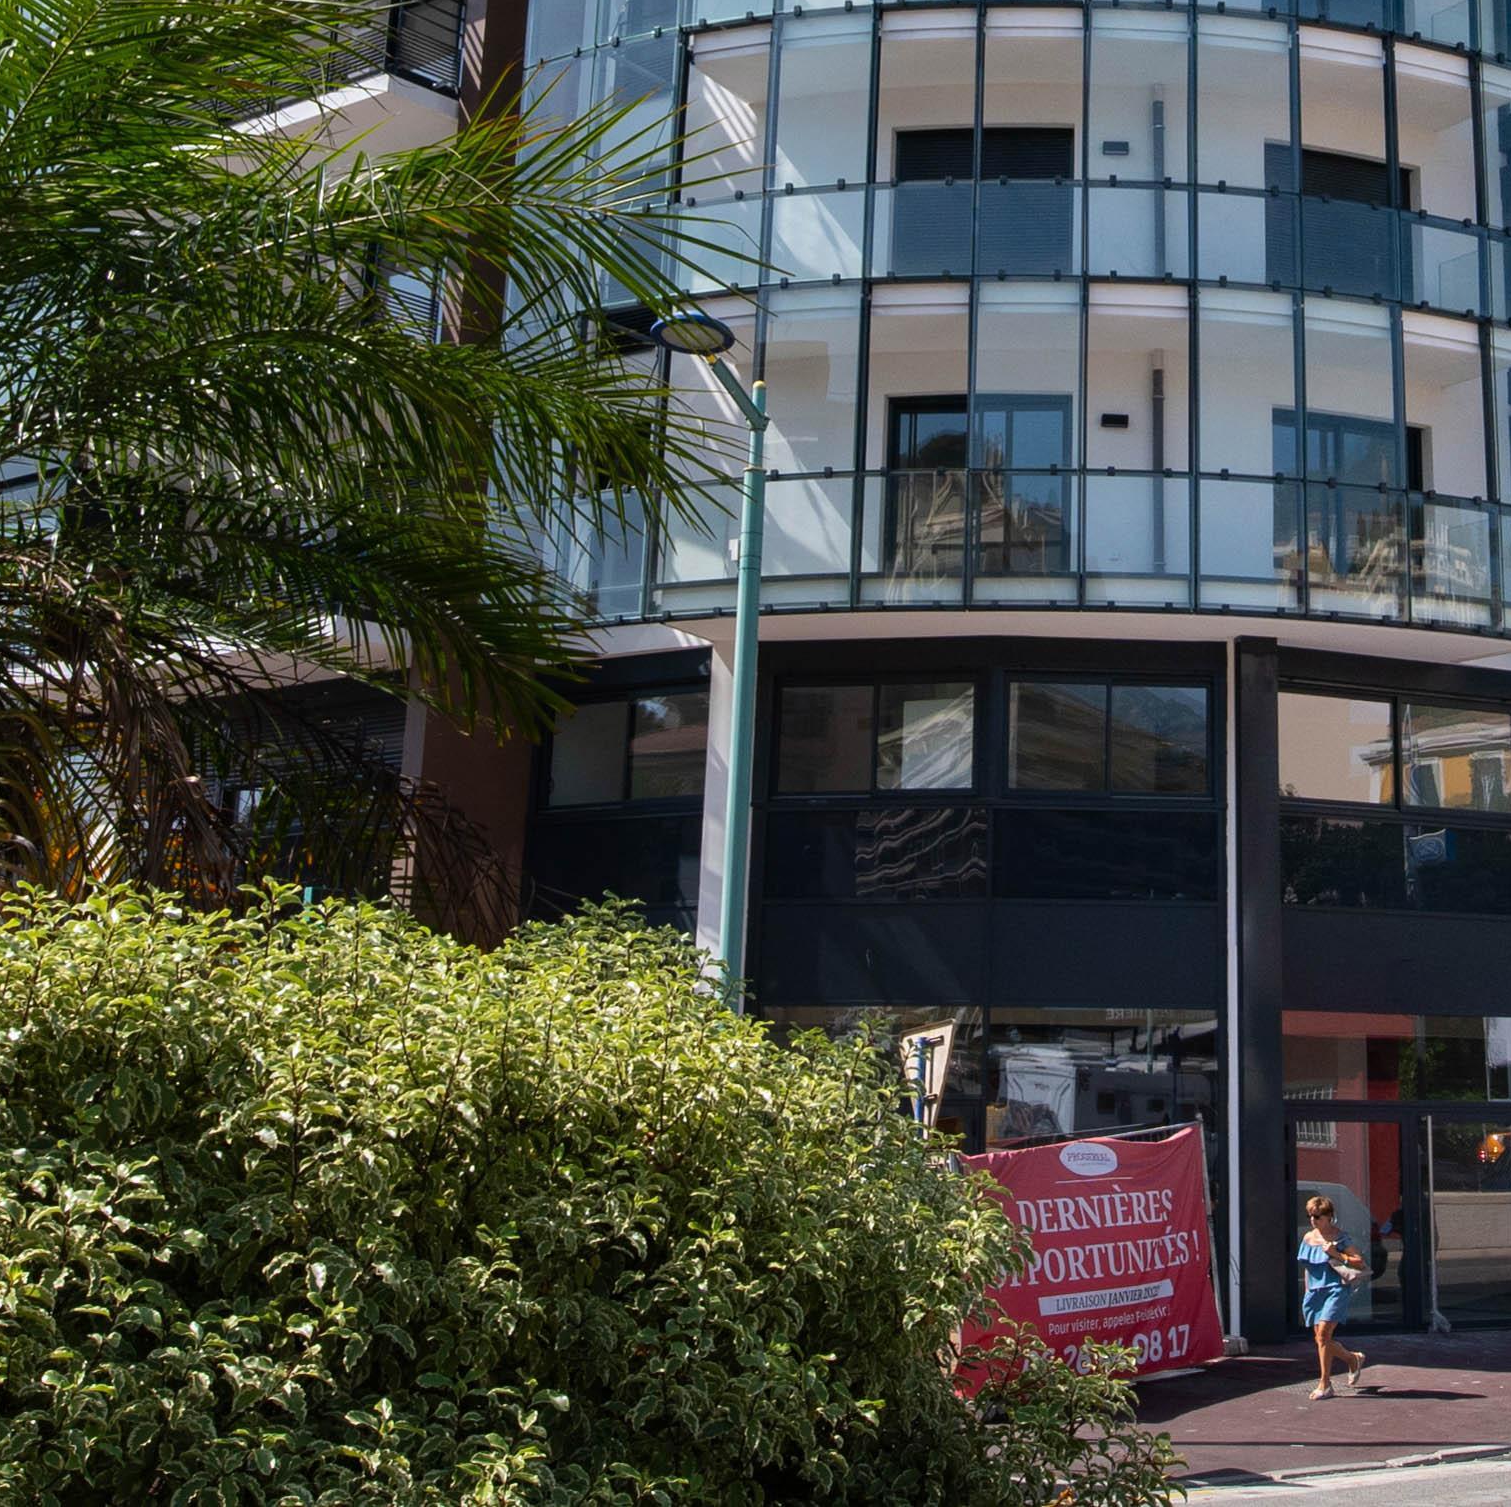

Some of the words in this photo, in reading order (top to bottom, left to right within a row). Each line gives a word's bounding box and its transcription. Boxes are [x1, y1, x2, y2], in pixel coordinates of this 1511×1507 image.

[1017, 1184, 1172, 1234] DERNIÈRES
[1192, 1230, 1200, 1261] !
[1056, 1293, 1108, 1312] LIVRAISON
[1108, 1288, 1141, 1307] JANVIER
[1048, 1323, 1070, 1335] Pour
[1072, 1319, 1102, 1332] visiter,
[1103, 1313, 1135, 1329] appelez
[1167, 1324, 1190, 1359] 17
